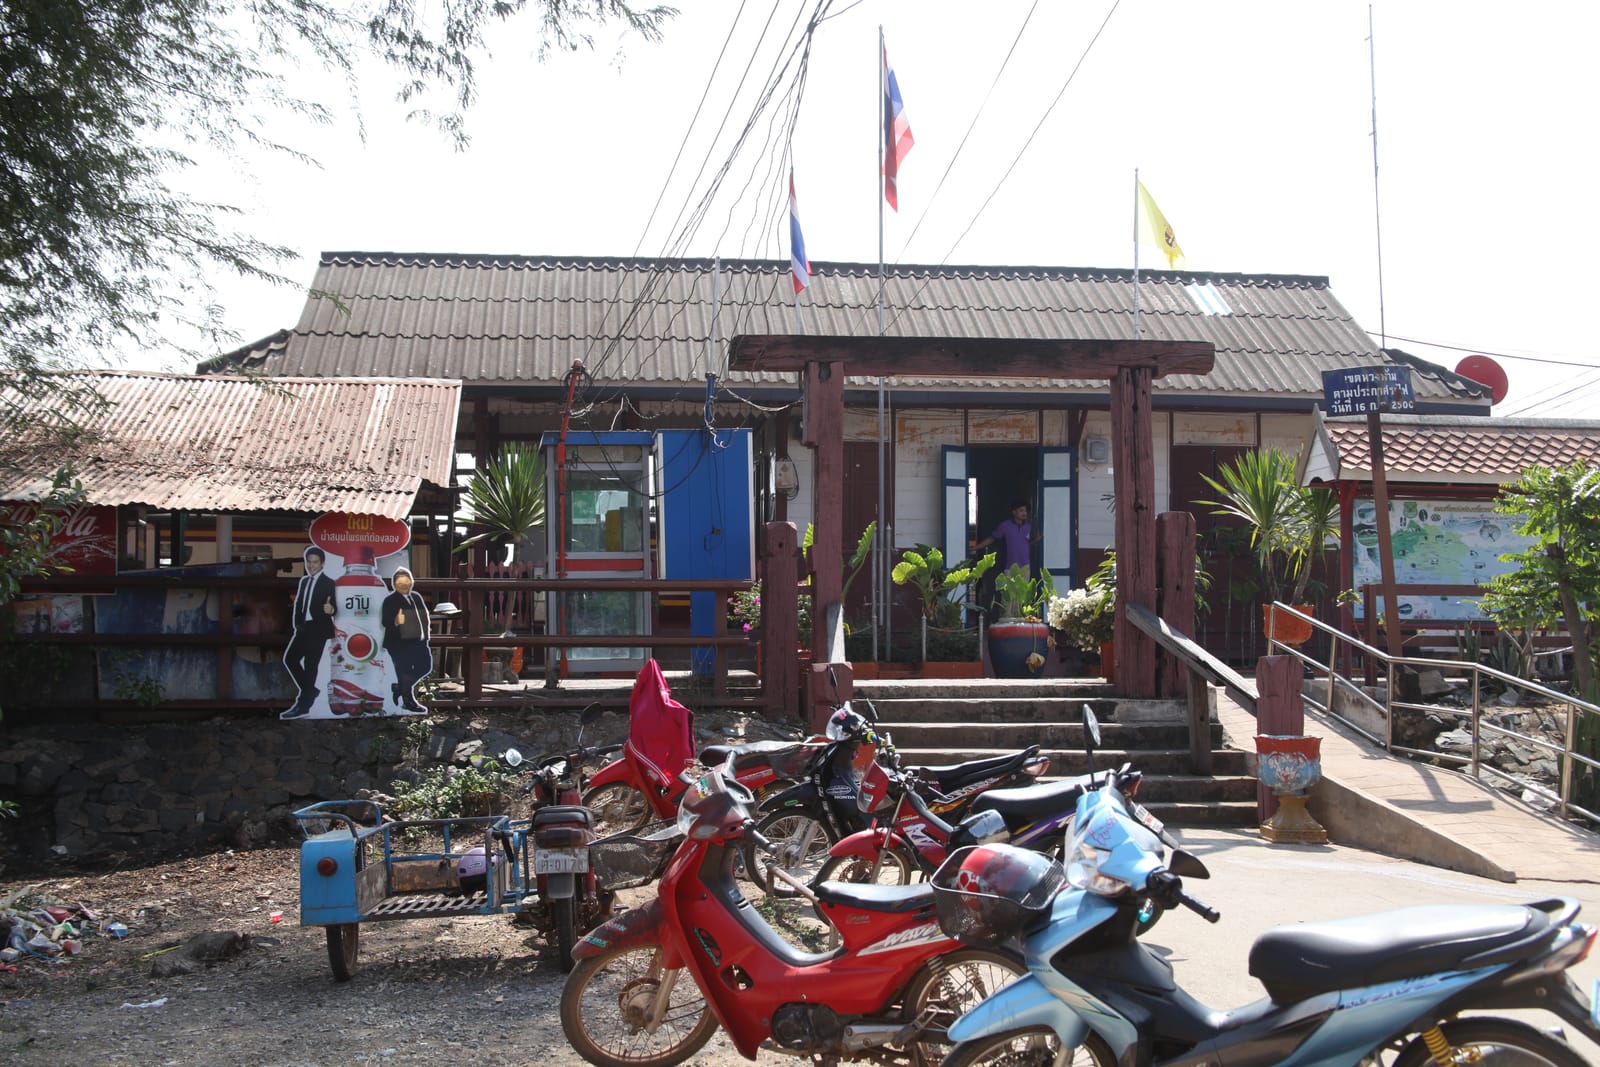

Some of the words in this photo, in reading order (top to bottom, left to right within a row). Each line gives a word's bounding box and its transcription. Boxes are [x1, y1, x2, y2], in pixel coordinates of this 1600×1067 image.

[1331, 397, 1352, 413] วันที่
[1355, 403, 1366, 411] 16
